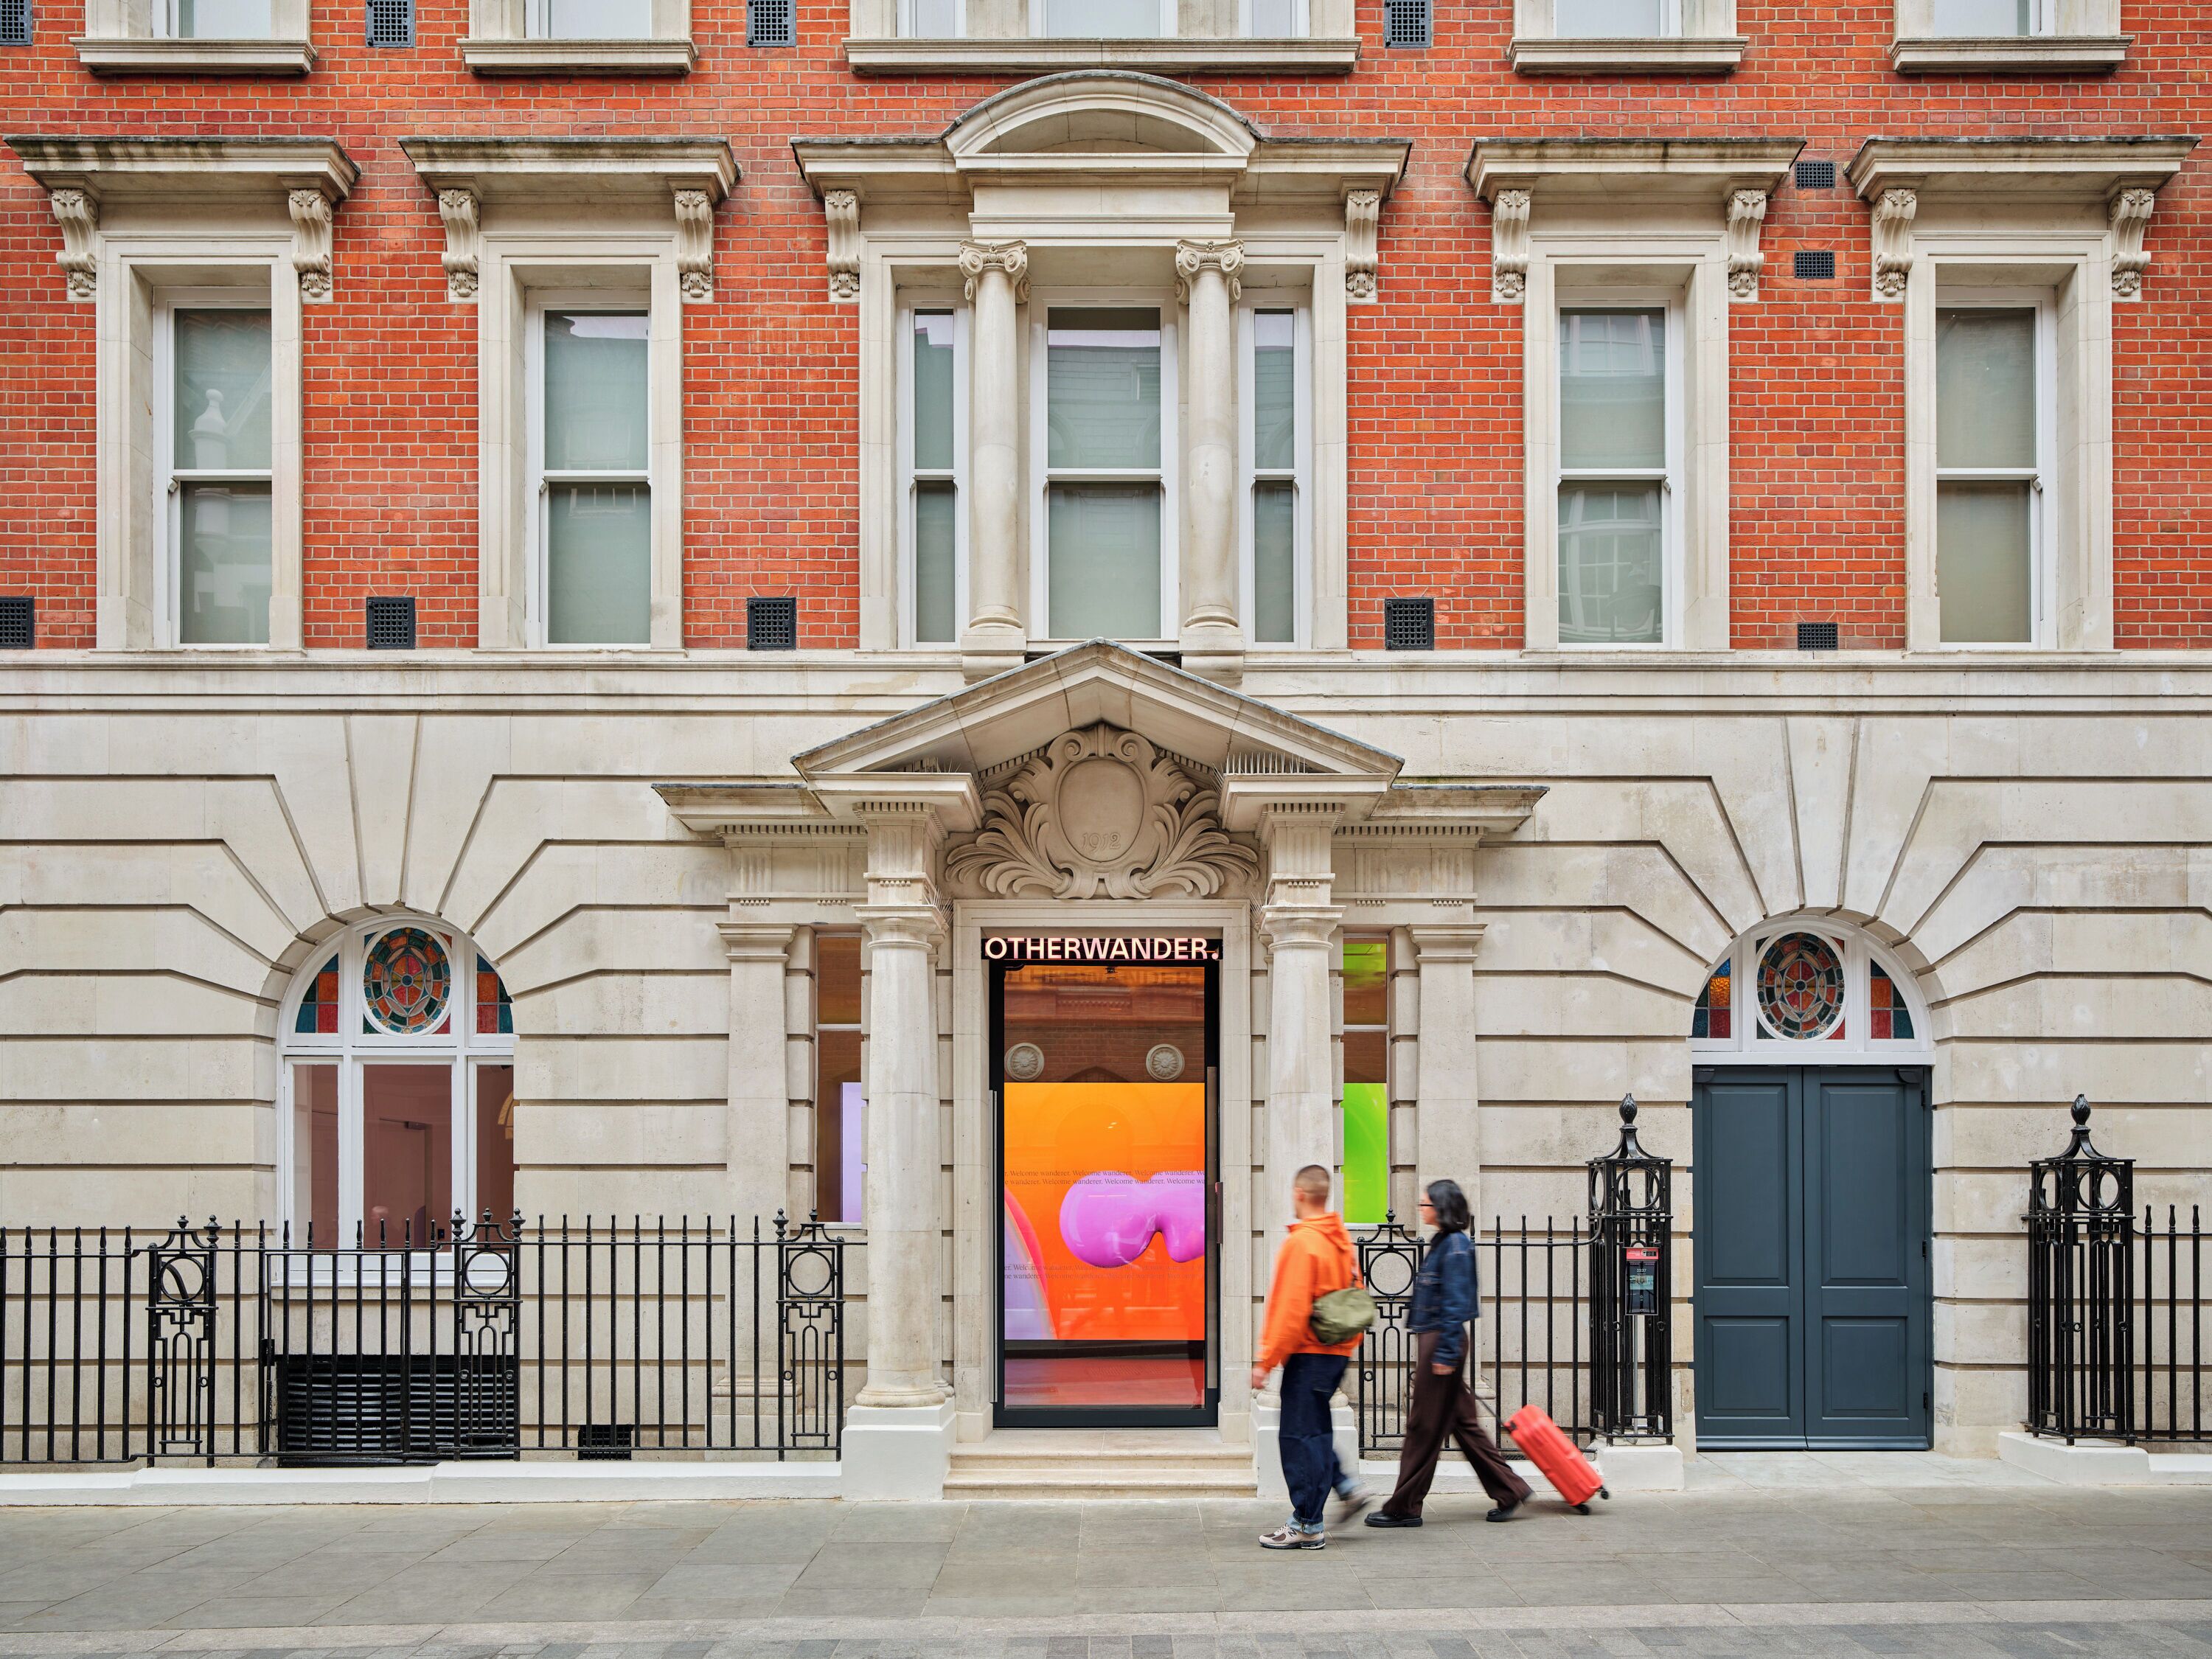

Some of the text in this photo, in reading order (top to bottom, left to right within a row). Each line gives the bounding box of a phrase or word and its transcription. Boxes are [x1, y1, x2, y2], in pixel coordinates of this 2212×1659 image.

[1081, 832, 1121, 852] 1912
[984, 936, 1219, 959] OTHERWANDER.
[1287, 1528, 1298, 1537] N
